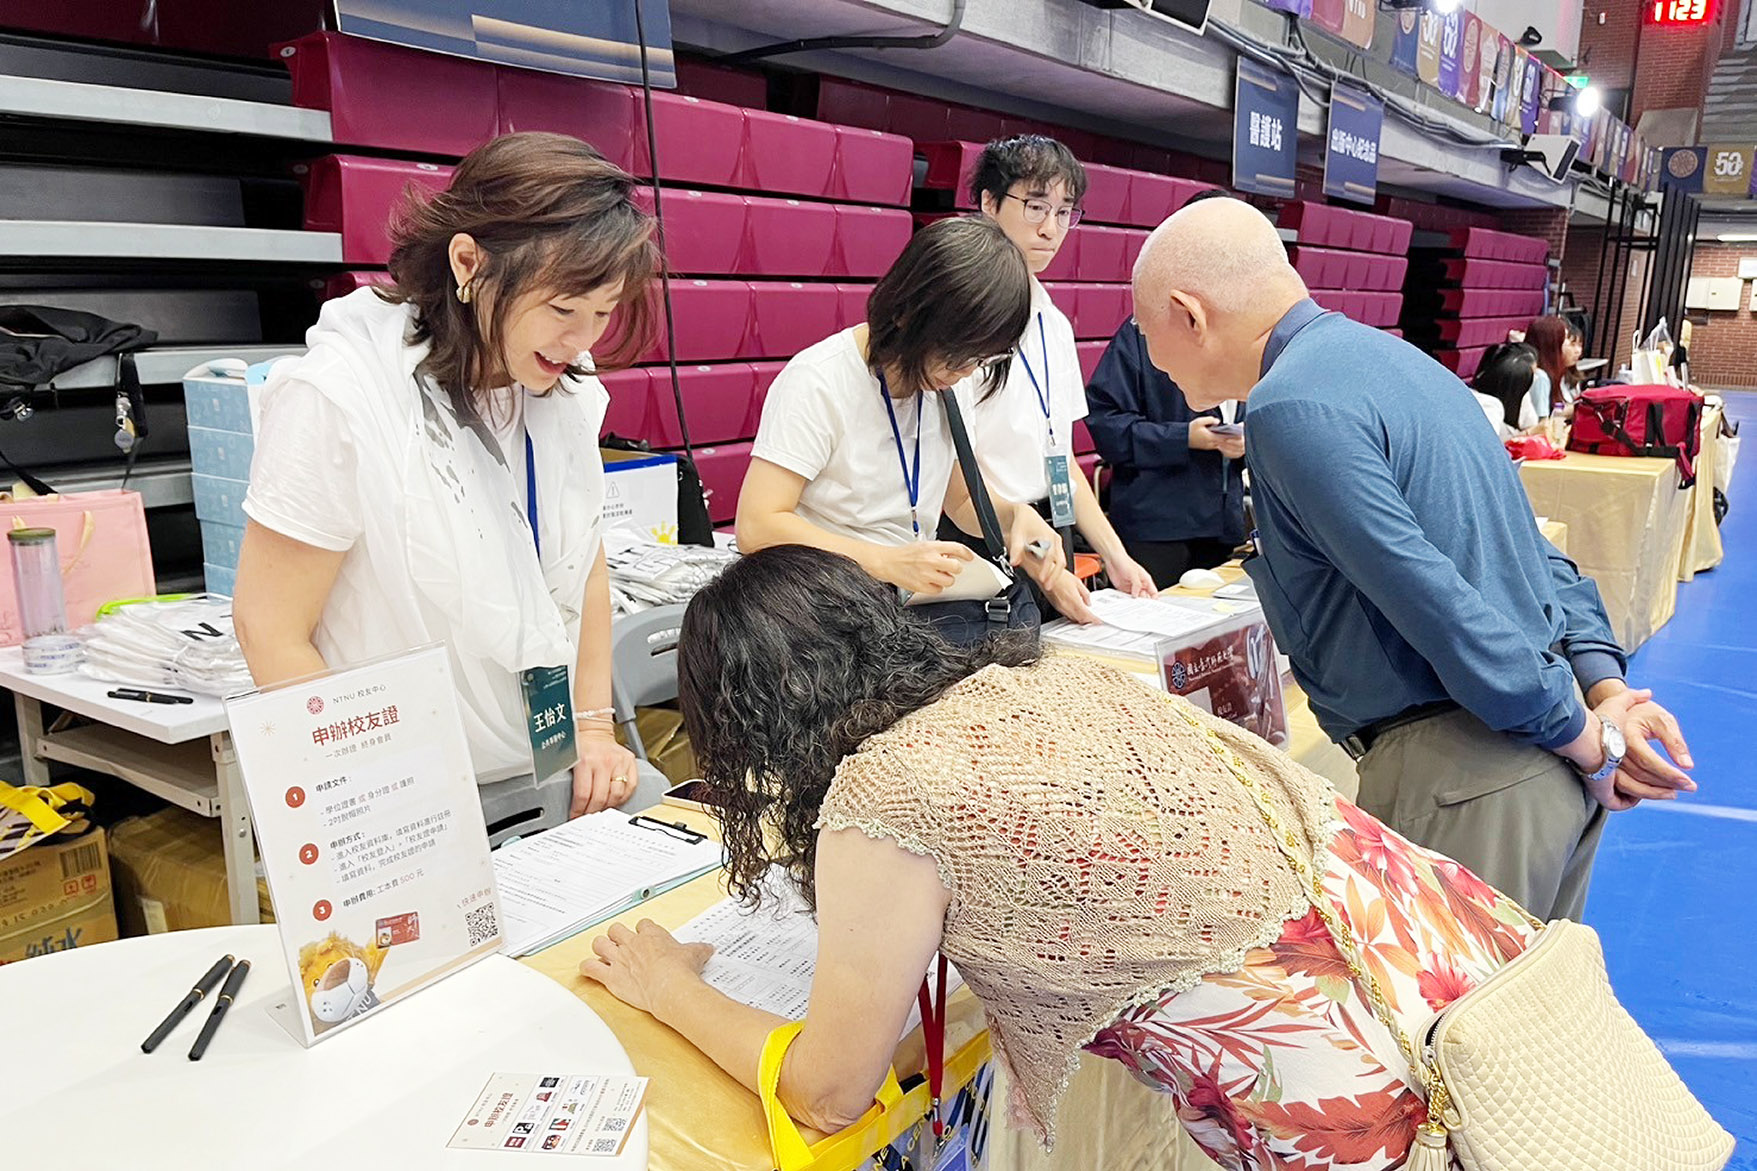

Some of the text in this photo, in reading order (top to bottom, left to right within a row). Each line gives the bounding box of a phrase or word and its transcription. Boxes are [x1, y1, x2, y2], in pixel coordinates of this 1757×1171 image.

[1249, 111, 1283, 151] 醫護站
[332, 684, 387, 705] NTNU 校友中心
[312, 704, 401, 747] 申辦校友證
[533, 702, 567, 733] 王怡文
